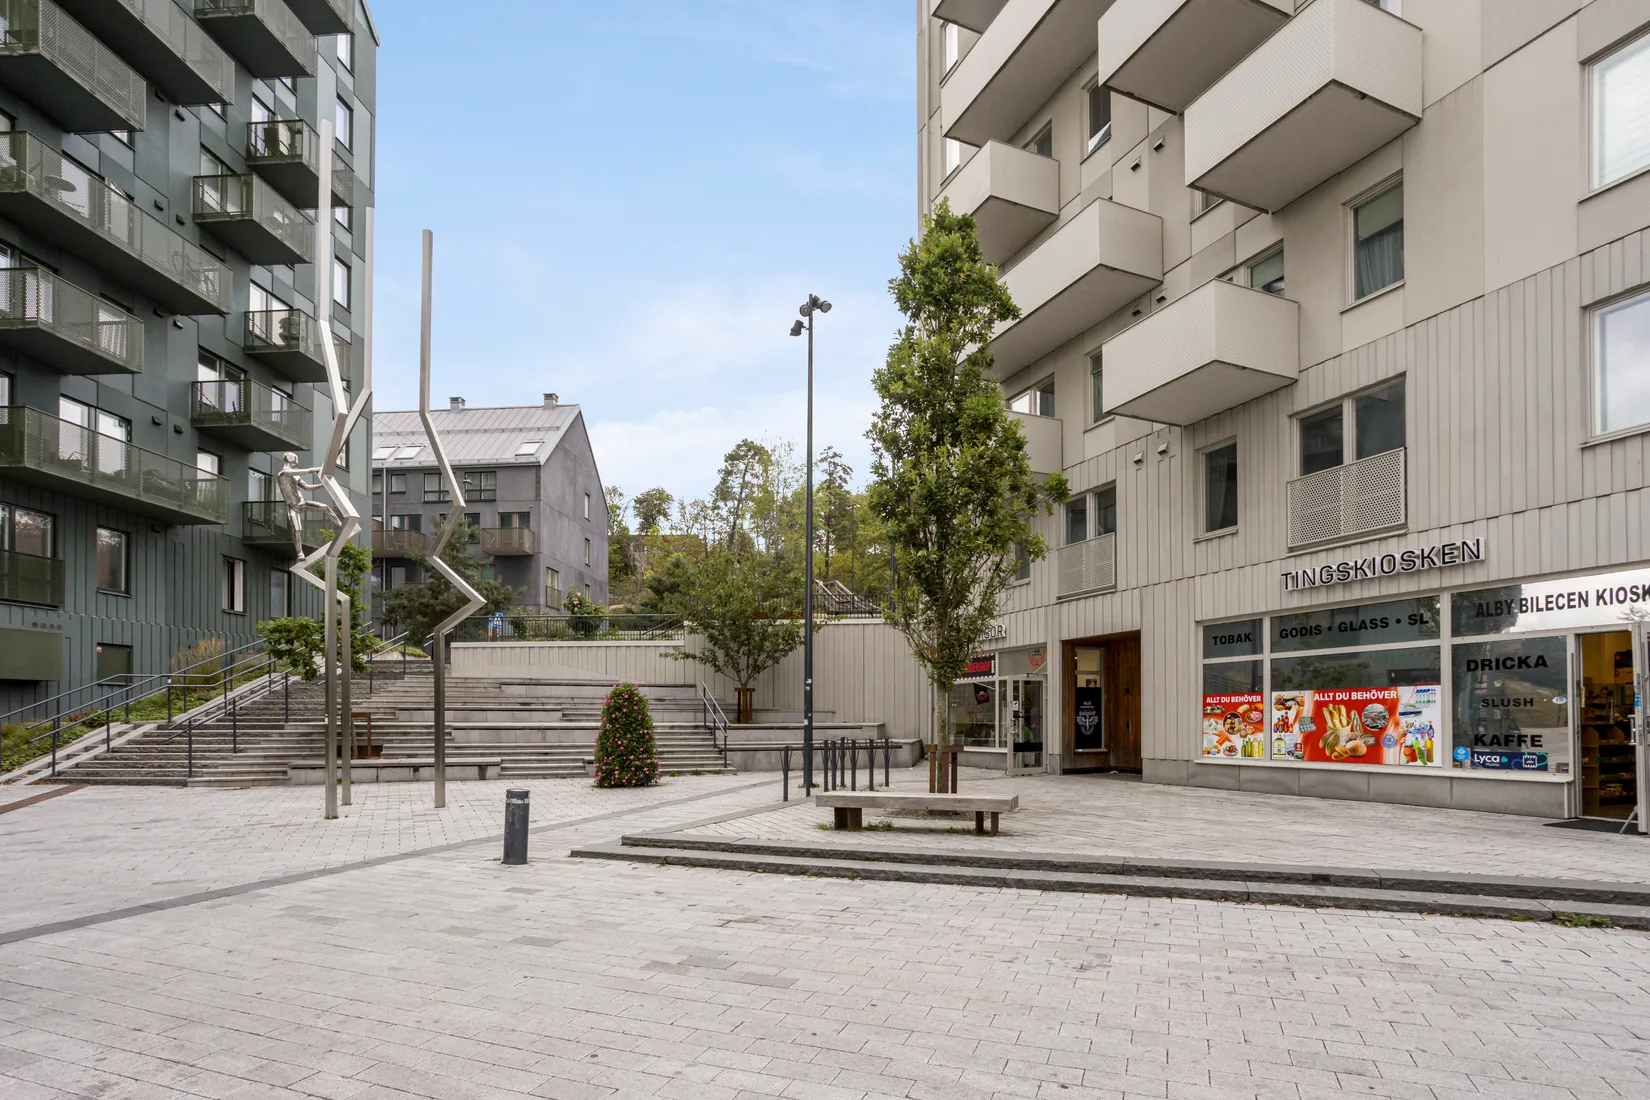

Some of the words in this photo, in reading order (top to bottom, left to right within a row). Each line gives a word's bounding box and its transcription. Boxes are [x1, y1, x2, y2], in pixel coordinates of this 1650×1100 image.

[1281, 538, 1483, 591] TINGSKIOSKEN
[1475, 598, 1515, 619] ALBY
[1519, 590, 1589, 614] BILECEN
[1596, 584, 1650, 607] KIOSK
[1279, 624, 1322, 639] GODIS
[1338, 616, 1389, 634] GLASS
[1407, 613, 1429, 626] SL
[1212, 632, 1252, 646] TOBAK
[1466, 654, 1549, 672] DRICKA
[1231, 694, 1261, 703] BEHÖVER
[1313, 692, 1334, 701] ALLT
[1335, 692, 1349, 700] DU
[1351, 689, 1397, 700] BEHÖVER
[1481, 697, 1534, 708] SLUSH
[1473, 733, 1543, 748] KAFFE
[1474, 753, 1500, 764] Lyca
